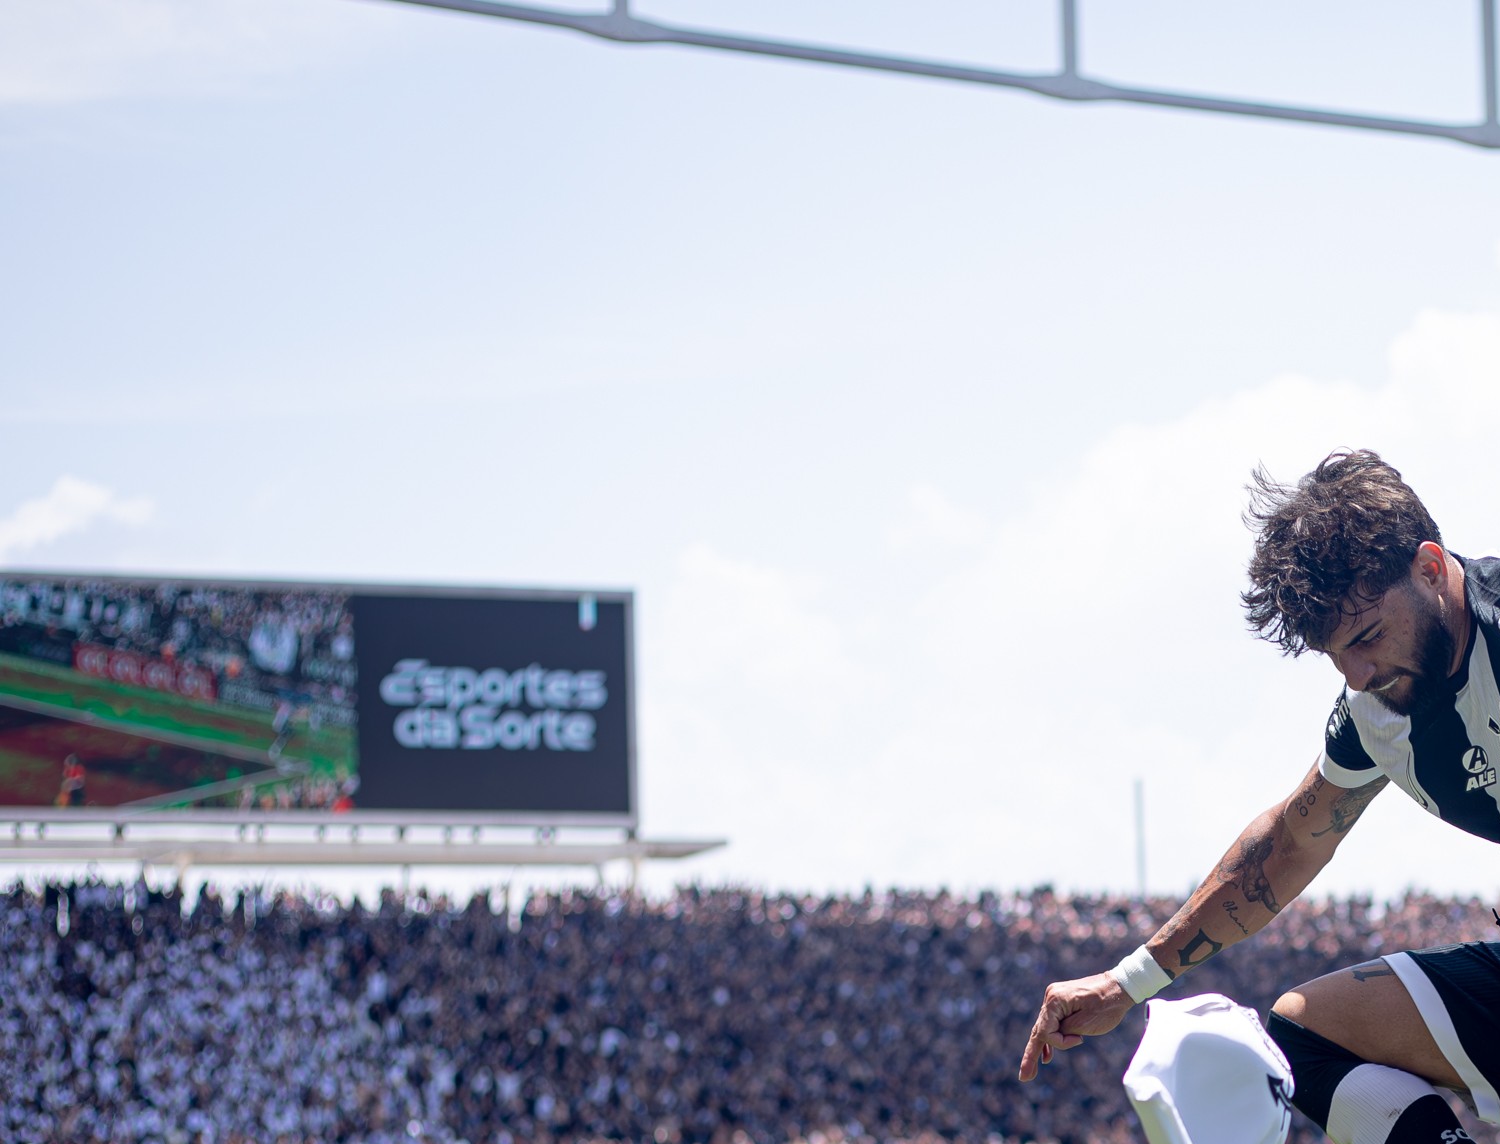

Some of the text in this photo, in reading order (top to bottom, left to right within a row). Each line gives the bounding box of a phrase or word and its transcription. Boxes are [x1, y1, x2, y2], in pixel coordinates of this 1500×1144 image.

[379, 658, 608, 710] Esportes
[461, 705, 597, 751] Sorte
[1466, 767, 1497, 792] ALE
